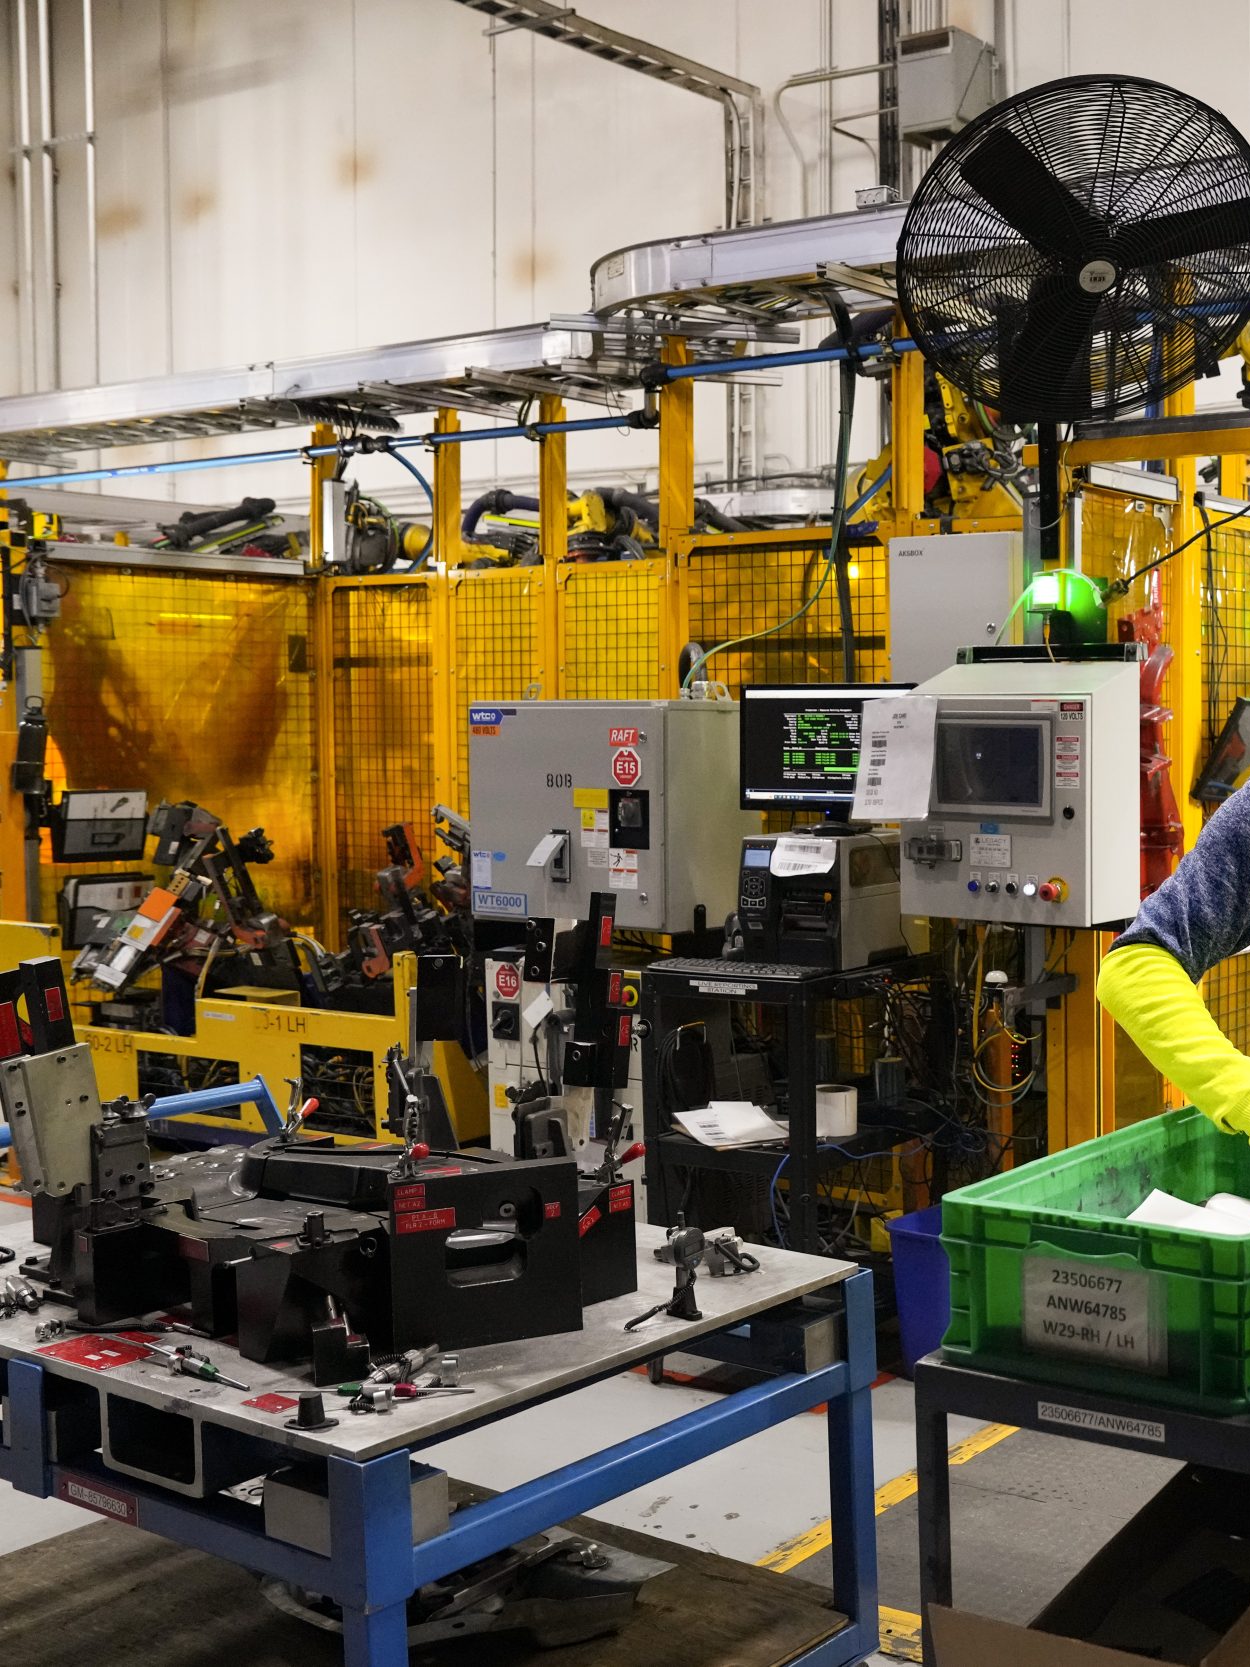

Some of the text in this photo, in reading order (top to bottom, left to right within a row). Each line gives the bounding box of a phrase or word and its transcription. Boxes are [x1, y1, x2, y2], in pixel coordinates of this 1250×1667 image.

[1069, 712, 1084, 720] VOLTS
[483, 726, 496, 735] VOLTS
[611, 729, 635, 743] RAFT
[616, 761, 636, 775] E15
[546, 773, 572, 788] 80B
[478, 894, 522, 908] WT6000
[499, 976, 517, 987] E16
[287, 1015, 306, 1034] LH
[115, 1035, 133, 1054] LH
[1052, 1269, 1122, 1293] 23506677
[1046, 1295, 1127, 1322] ANW64785
[1043, 1320, 1135, 1349] W29-RH / LH
[1040, 1404, 1162, 1438] 23506677/ANW64785
[70, 1483, 127, 1516] GM-85796630
